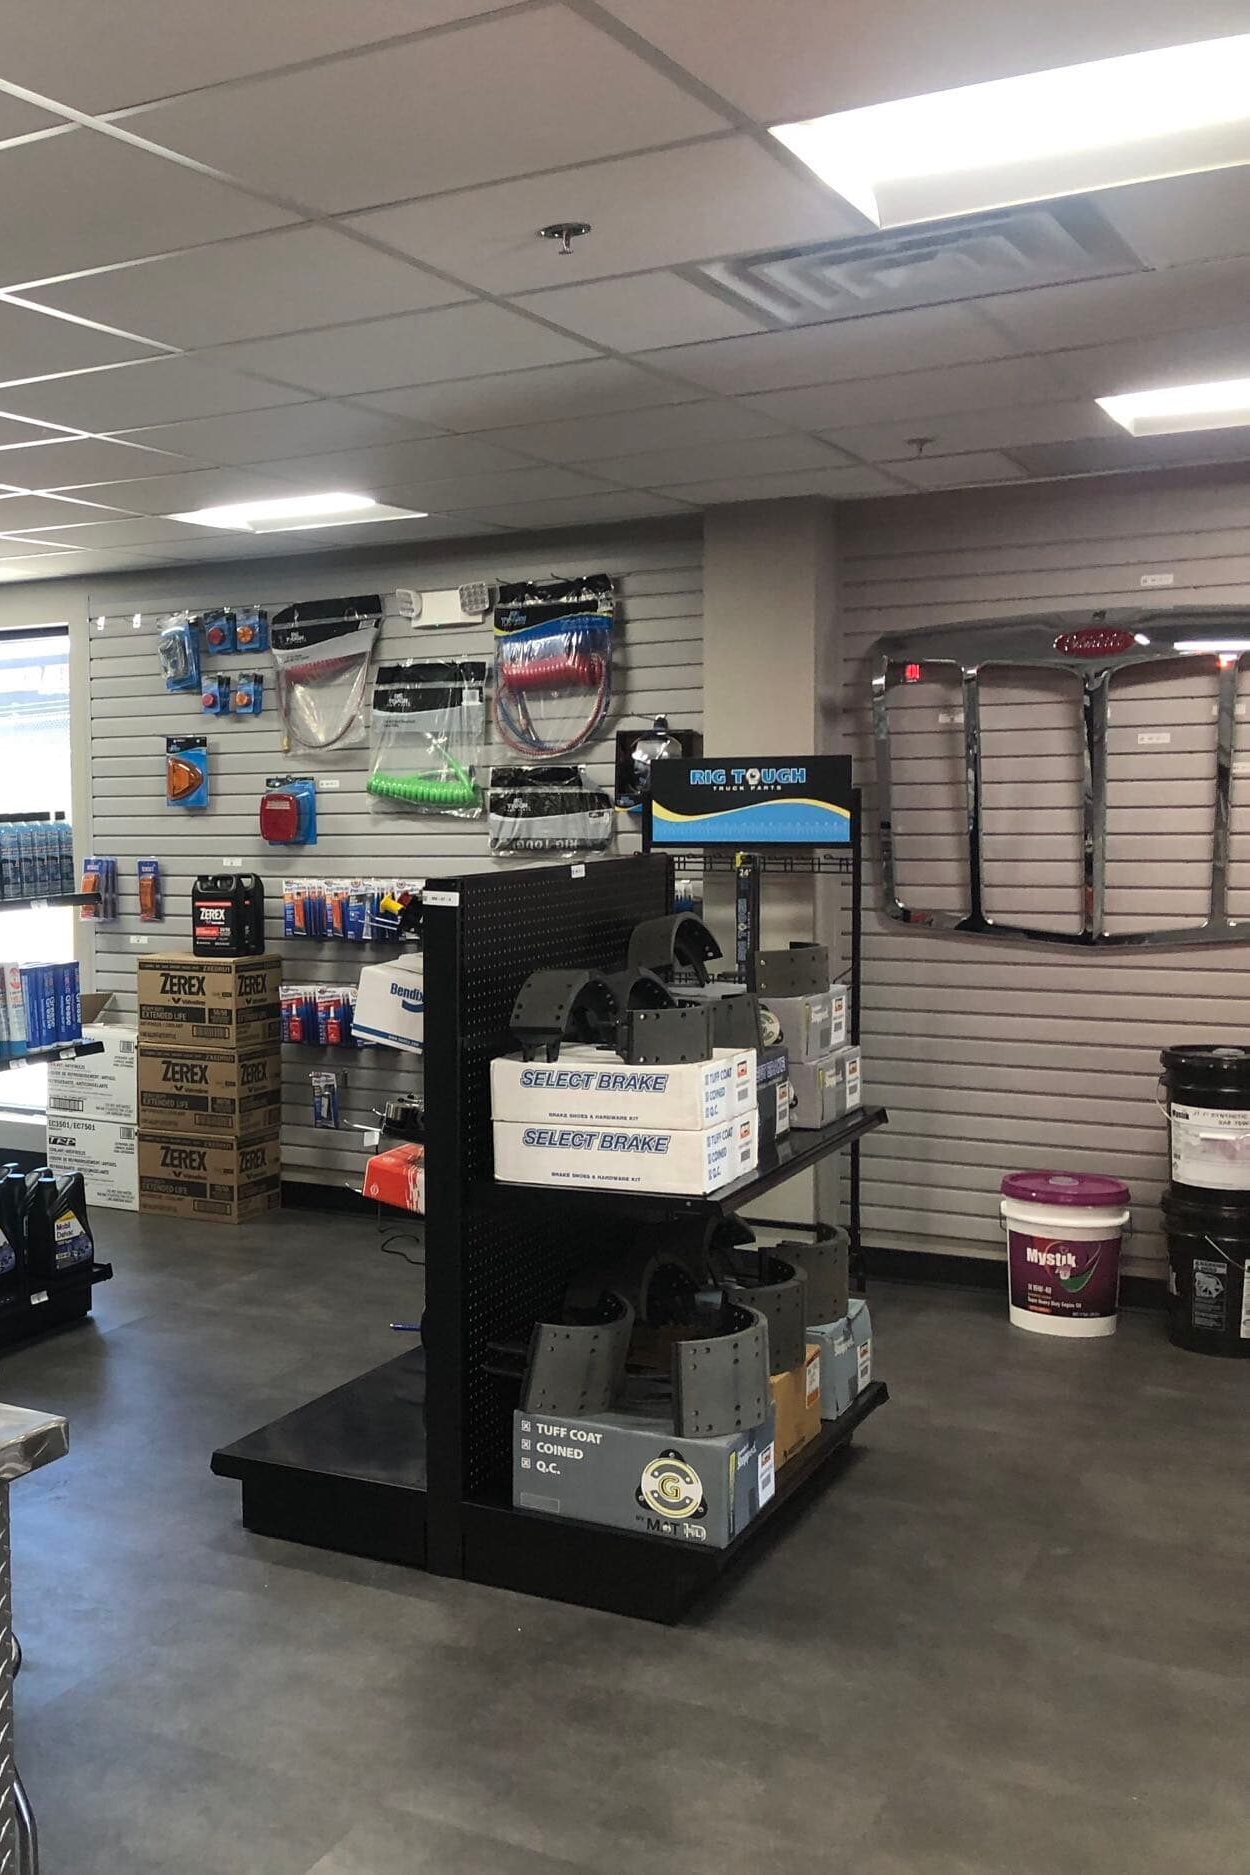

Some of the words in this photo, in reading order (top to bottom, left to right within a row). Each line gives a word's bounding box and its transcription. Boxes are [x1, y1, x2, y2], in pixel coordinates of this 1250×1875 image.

[690, 769, 726, 785] RIG
[731, 767, 806, 785] TOUGH
[200, 908, 225, 920] ZEREX
[160, 973, 206, 996] ZEREX
[238, 973, 267, 997] ZEREX
[142, 1011, 172, 1020] EXTENDED
[173, 1013, 187, 1021] LIFE
[161, 1060, 209, 1084] ZEREX
[240, 1061, 268, 1086] ZEREX
[520, 1069, 595, 1090] SELECT
[597, 1072, 669, 1093] BRAKE
[710, 1070, 720, 1081] TUFF
[721, 1067, 732, 1080] COAT
[710, 1086, 725, 1101] COINED
[49, 1120, 95, 1131] EC3501/EC7501
[523, 1128, 598, 1150] SELECT
[599, 1132, 671, 1155] BRAKE
[711, 1133, 721, 1146] TUFF
[722, 1127, 733, 1141] COAT
[160, 1145, 207, 1171] ZEREX
[239, 1148, 267, 1174] ZEREX
[56, 1222, 70, 1230] Mobil
[56, 1230, 74, 1238] Delvac
[1026, 1247, 1076, 1268] Mystik
[536, 1423, 567, 1438] TUFF
[569, 1429, 603, 1445] COAT
[536, 1442, 584, 1460] COINED
[536, 1460, 561, 1474] Q.C.
[659, 1475, 680, 1499] G
[683, 1522, 707, 1541] HD
